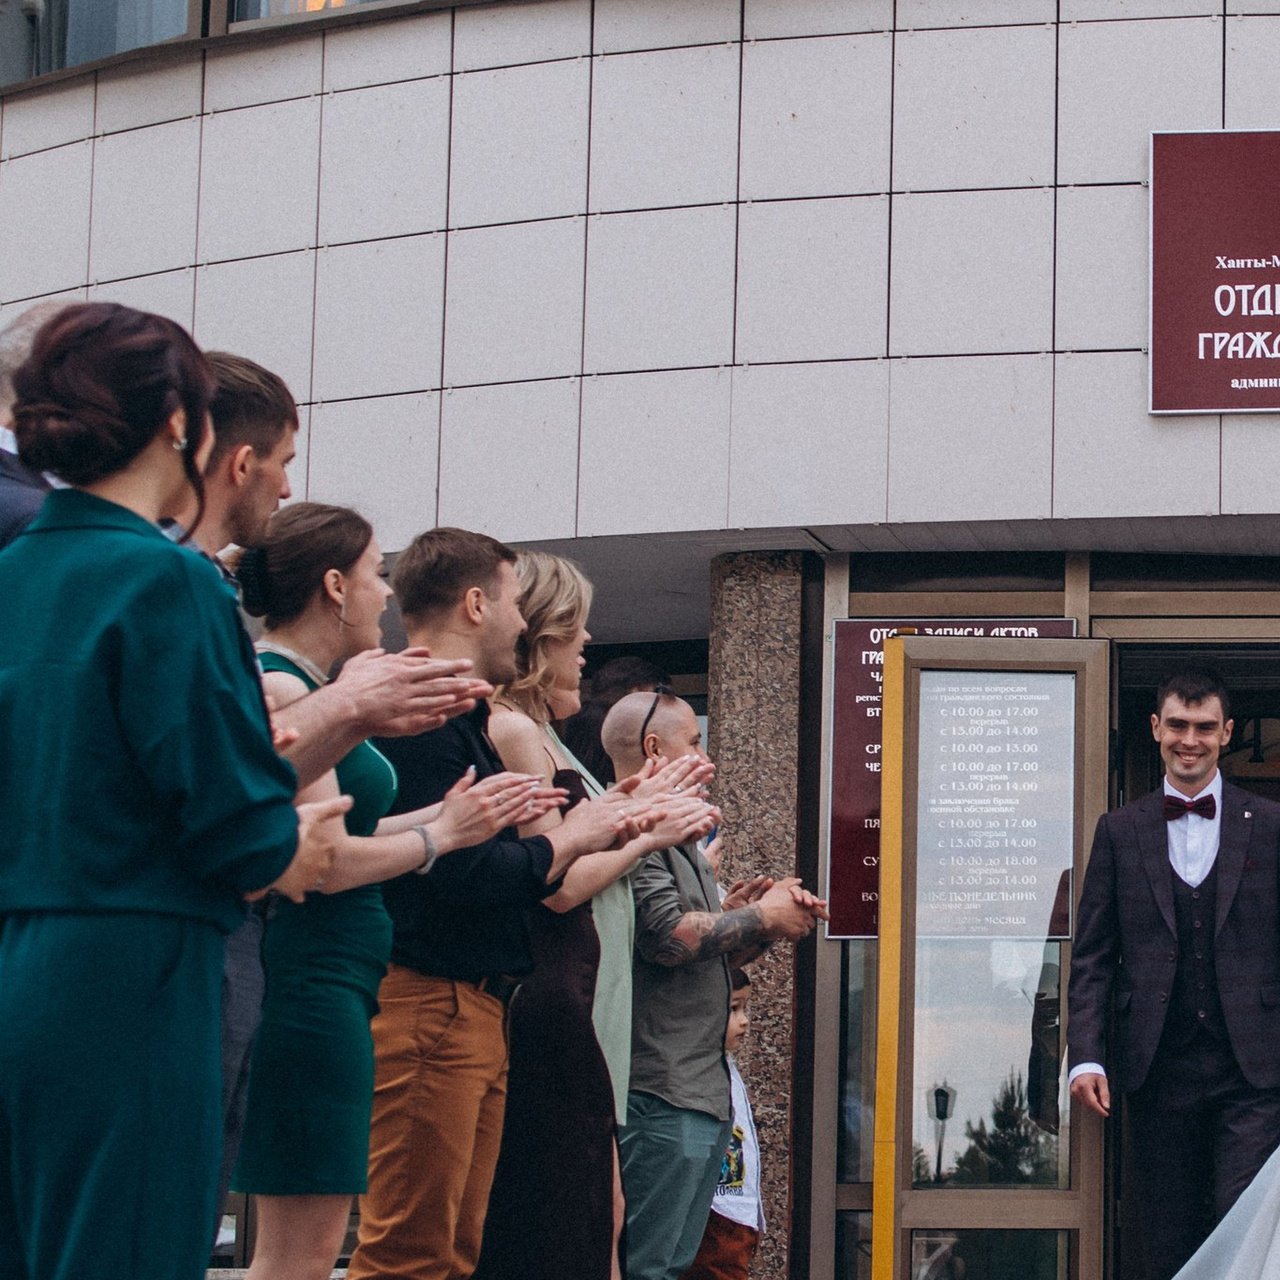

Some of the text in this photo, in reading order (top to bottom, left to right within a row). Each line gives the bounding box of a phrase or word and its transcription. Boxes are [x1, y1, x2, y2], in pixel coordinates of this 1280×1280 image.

[951, 707, 984, 717] 10.00
[986, 708, 1002, 718] до
[1006, 707, 1038, 717] 17.00
[986, 728, 1002, 737] до
[1006, 726, 1038, 736] 14.00
[951, 743, 984, 753] 10.00
[986, 745, 1002, 754] до
[951, 762, 984, 772] 10.00
[986, 763, 1002, 773] до
[1006, 762, 1038, 772] 17.00
[986, 783, 1002, 792] до
[1006, 782, 1038, 791] 14.00
[950, 818, 982, 828] 10.00
[1004, 818, 1037, 828] 17.00
[1004, 838, 1037, 847] 14.00
[950, 856, 983, 866] 10.00
[1004, 856, 1037, 866] 18.00
[1004, 875, 1037, 885] 14.00
[950, 891, 1038, 901] ПОНЕДЕЛЬНИК
